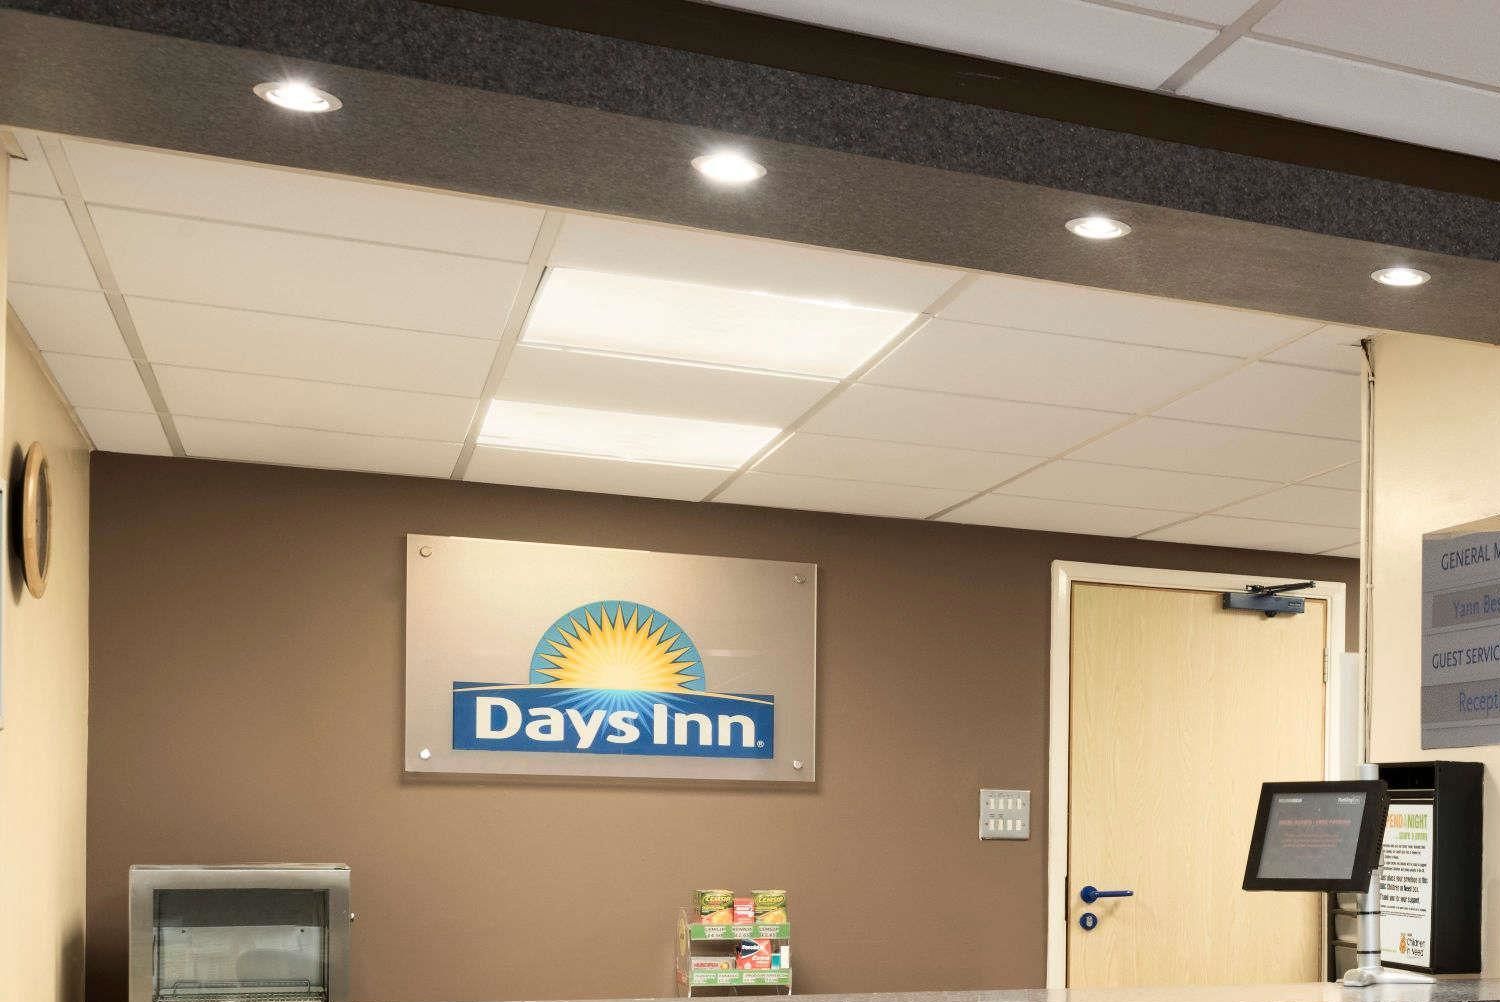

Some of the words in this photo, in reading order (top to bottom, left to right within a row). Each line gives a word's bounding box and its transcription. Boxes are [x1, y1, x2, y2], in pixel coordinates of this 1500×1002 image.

[1440, 543, 1491, 571] GENERAL
[1432, 650, 1463, 669] GUEST
[475, 696, 641, 749] Days
[653, 703, 756, 748] Inn
